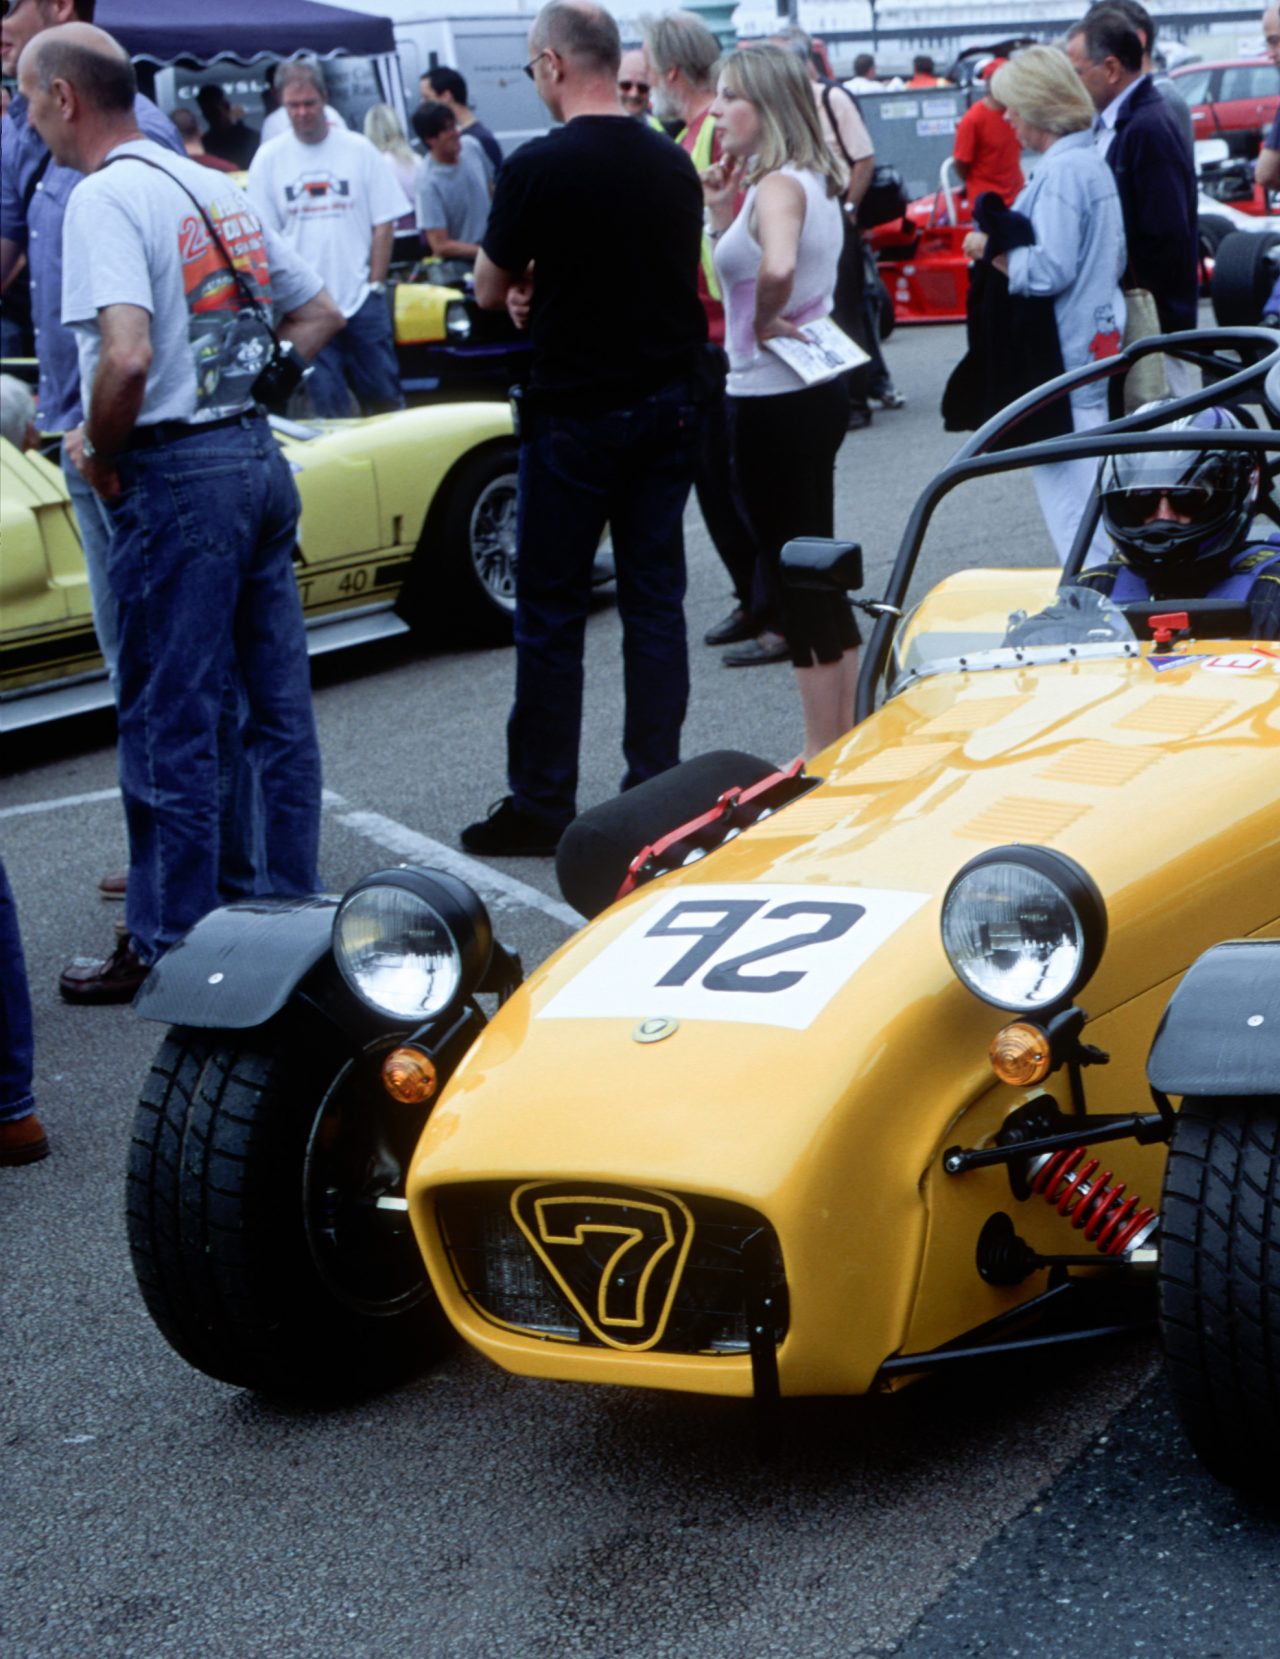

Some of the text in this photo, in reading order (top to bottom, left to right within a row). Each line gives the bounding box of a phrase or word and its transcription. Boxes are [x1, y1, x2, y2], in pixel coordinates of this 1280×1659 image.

[338, 568, 368, 594] 40
[645, 898, 867, 993] 92
[534, 1194, 676, 1328] 7
